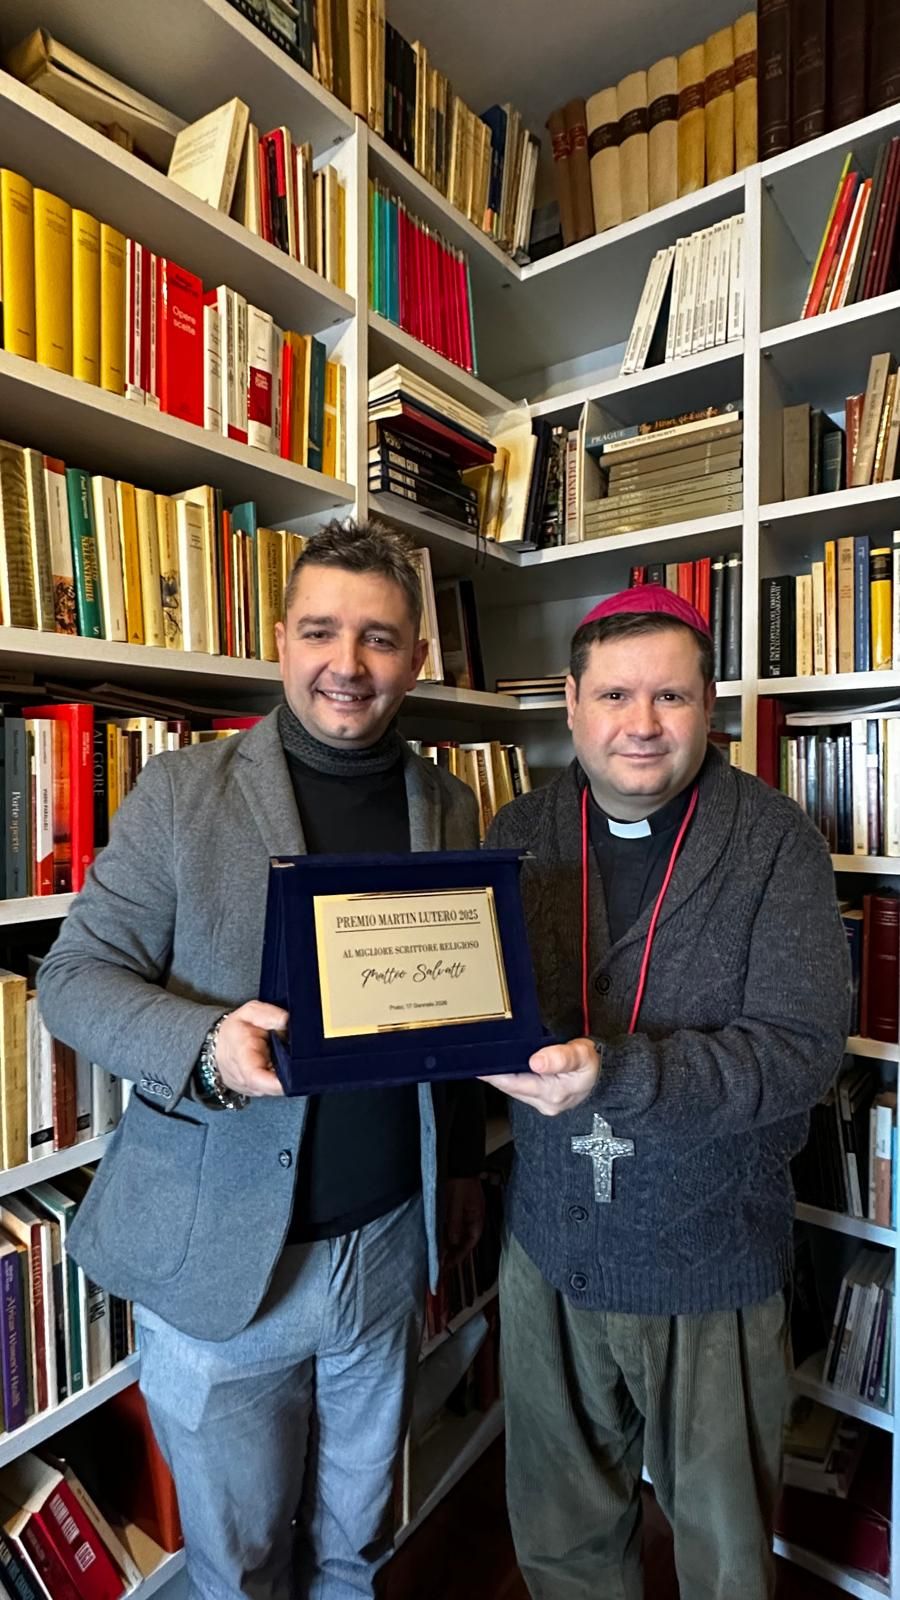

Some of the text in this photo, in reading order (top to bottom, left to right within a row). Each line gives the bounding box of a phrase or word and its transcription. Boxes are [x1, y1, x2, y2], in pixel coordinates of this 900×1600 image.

[172, 305, 197, 326] Opere
[173, 319, 197, 337] scelte
[591, 430, 625, 444] PRAGUE
[567, 459, 578, 509] MONDO
[93, 752, 104, 797] GORE
[10, 790, 21, 854] Porte aperte
[336, 908, 479, 929] PREMIO MARTIN LUTERO 2025
[343, 940, 480, 959] AL MIGLIORE SCRITTORE RELIGIOSO
[360, 967, 407, 988] Matteo
[7, 1296, 19, 1331] African
